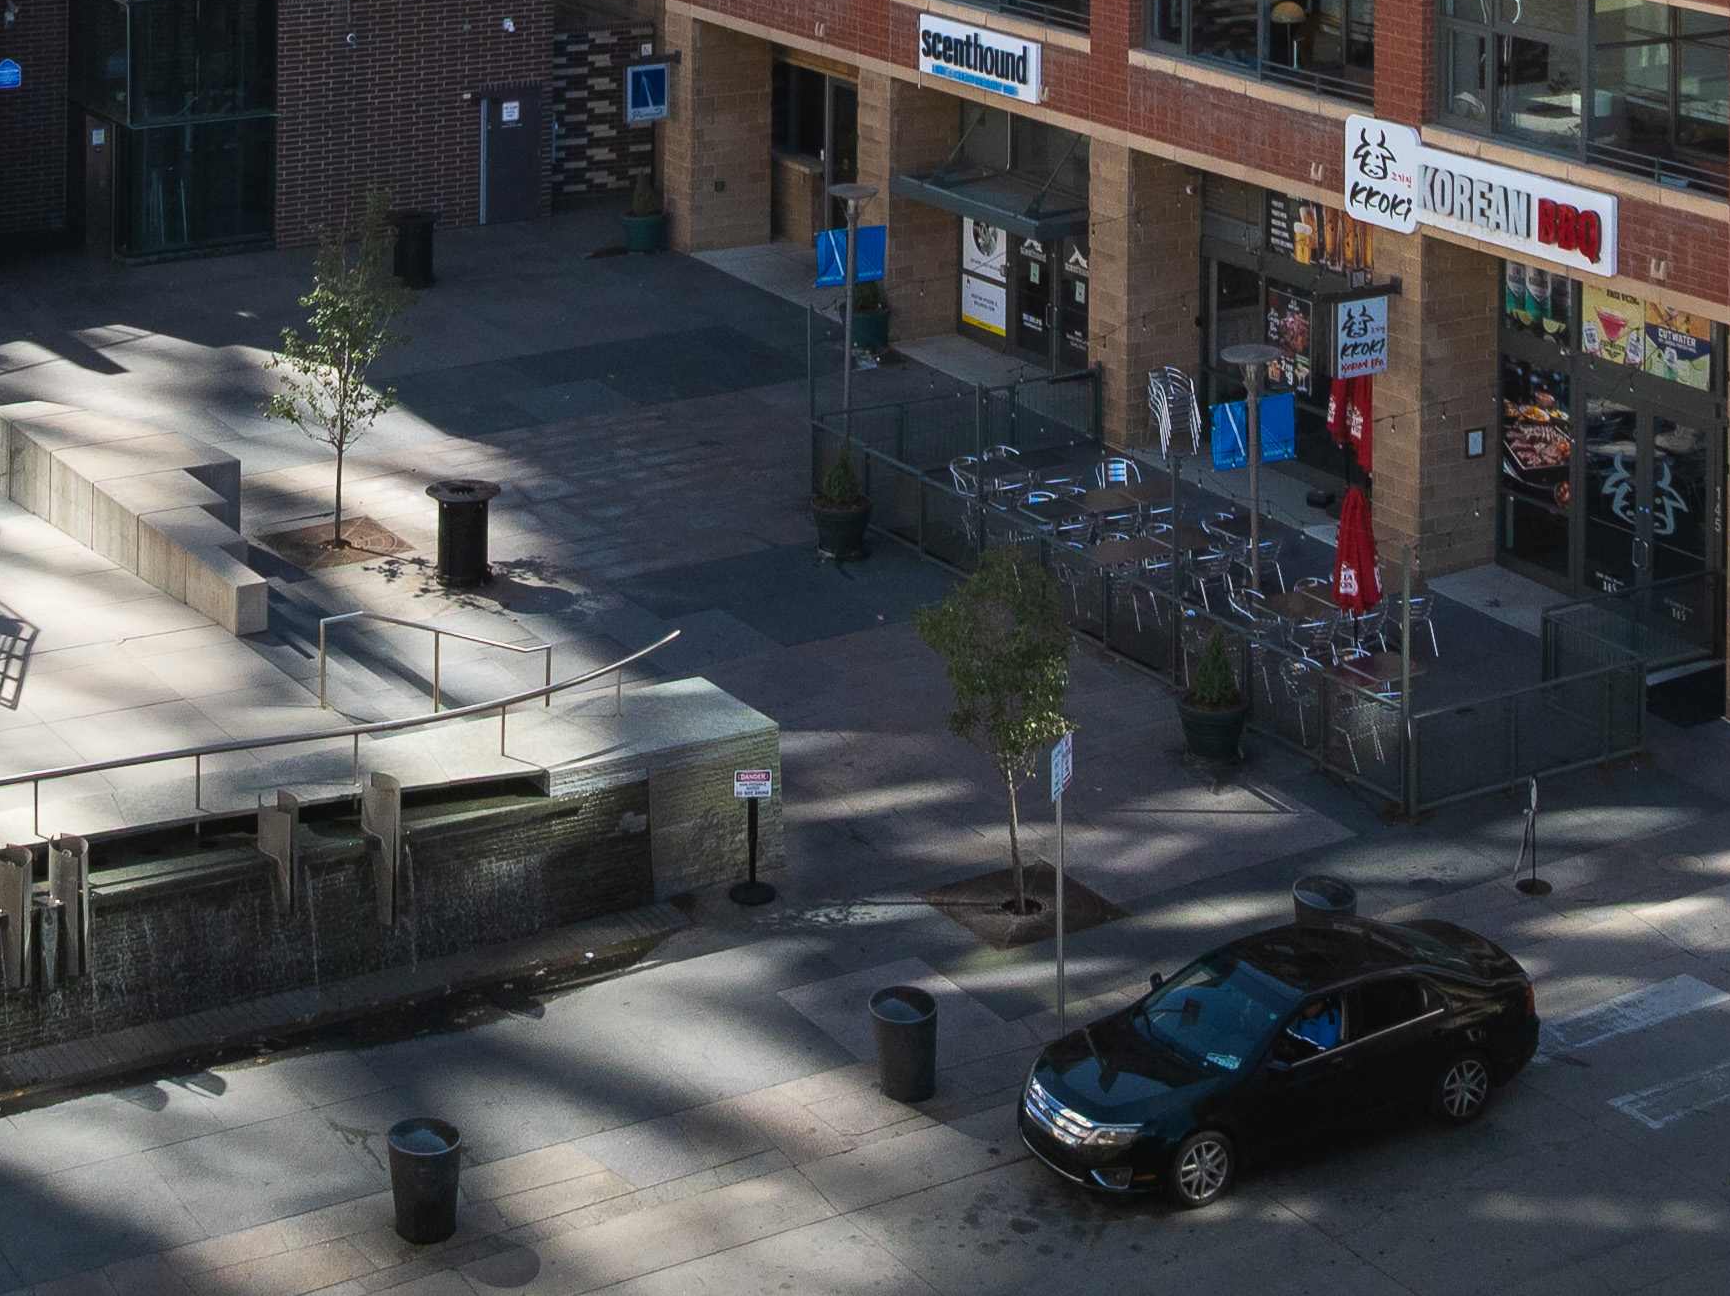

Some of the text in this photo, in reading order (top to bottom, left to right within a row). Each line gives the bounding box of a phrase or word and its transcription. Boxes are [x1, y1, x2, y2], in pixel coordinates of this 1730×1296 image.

[921, 28, 1028, 86] scenthound
[1418, 164, 1603, 265] KOREAN BBQ
[1658, 327, 1696, 348] CUTWATER
